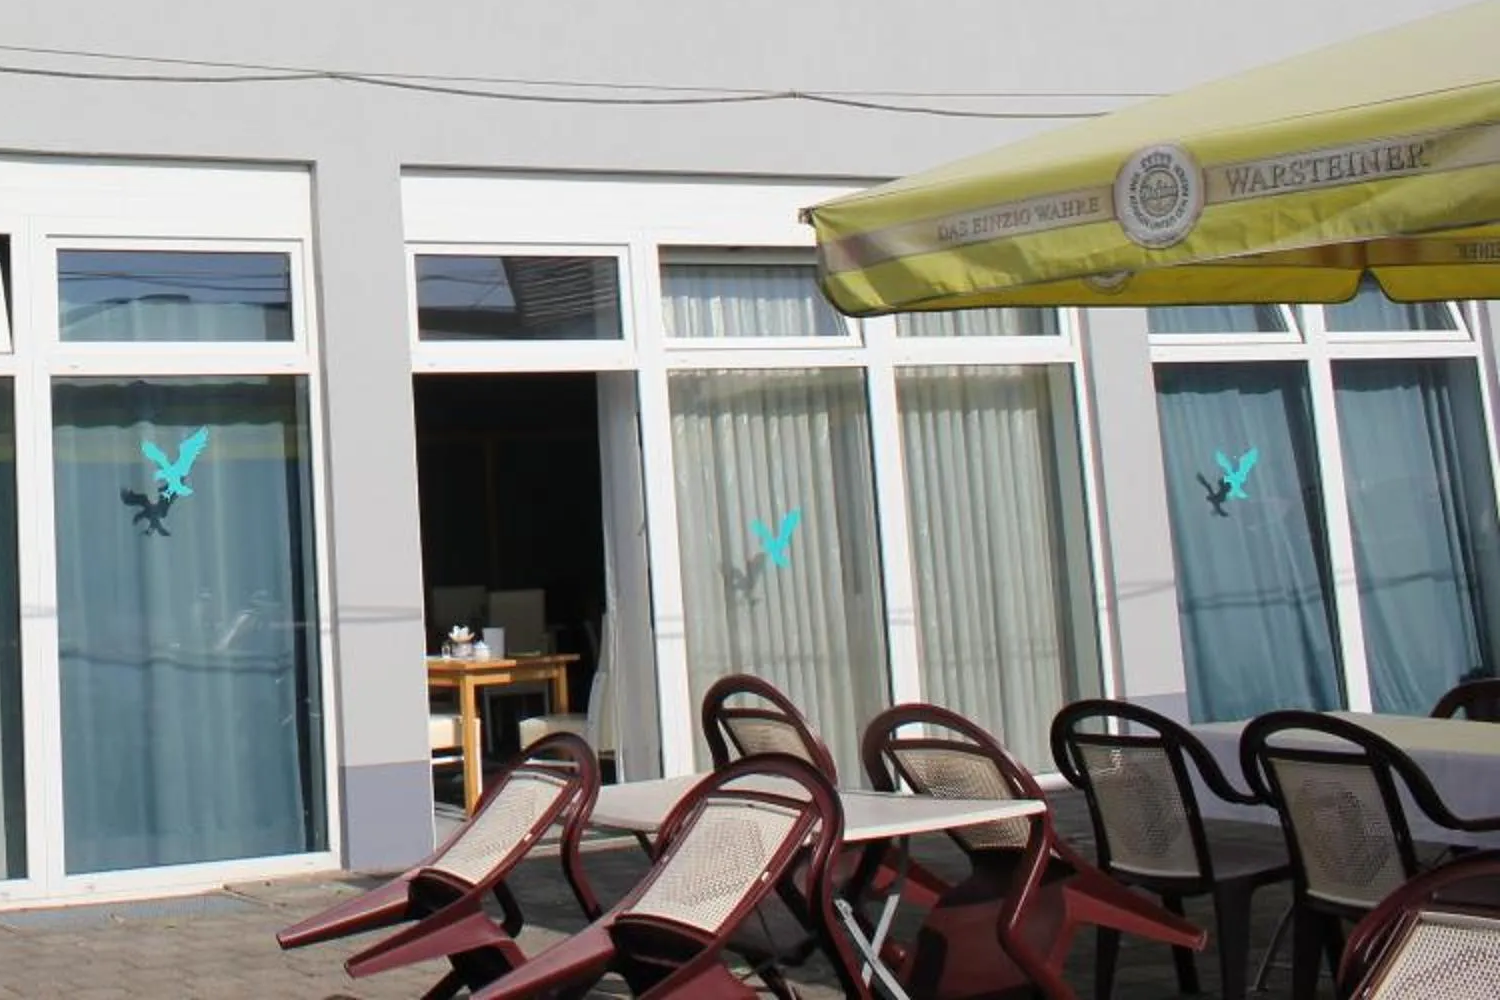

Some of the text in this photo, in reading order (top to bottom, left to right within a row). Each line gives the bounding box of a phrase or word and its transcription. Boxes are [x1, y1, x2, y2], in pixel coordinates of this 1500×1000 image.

[1225, 141, 1431, 196] WARSTEINER
[937, 220, 968, 241] DAS
[1034, 196, 1100, 224] WAHRE
